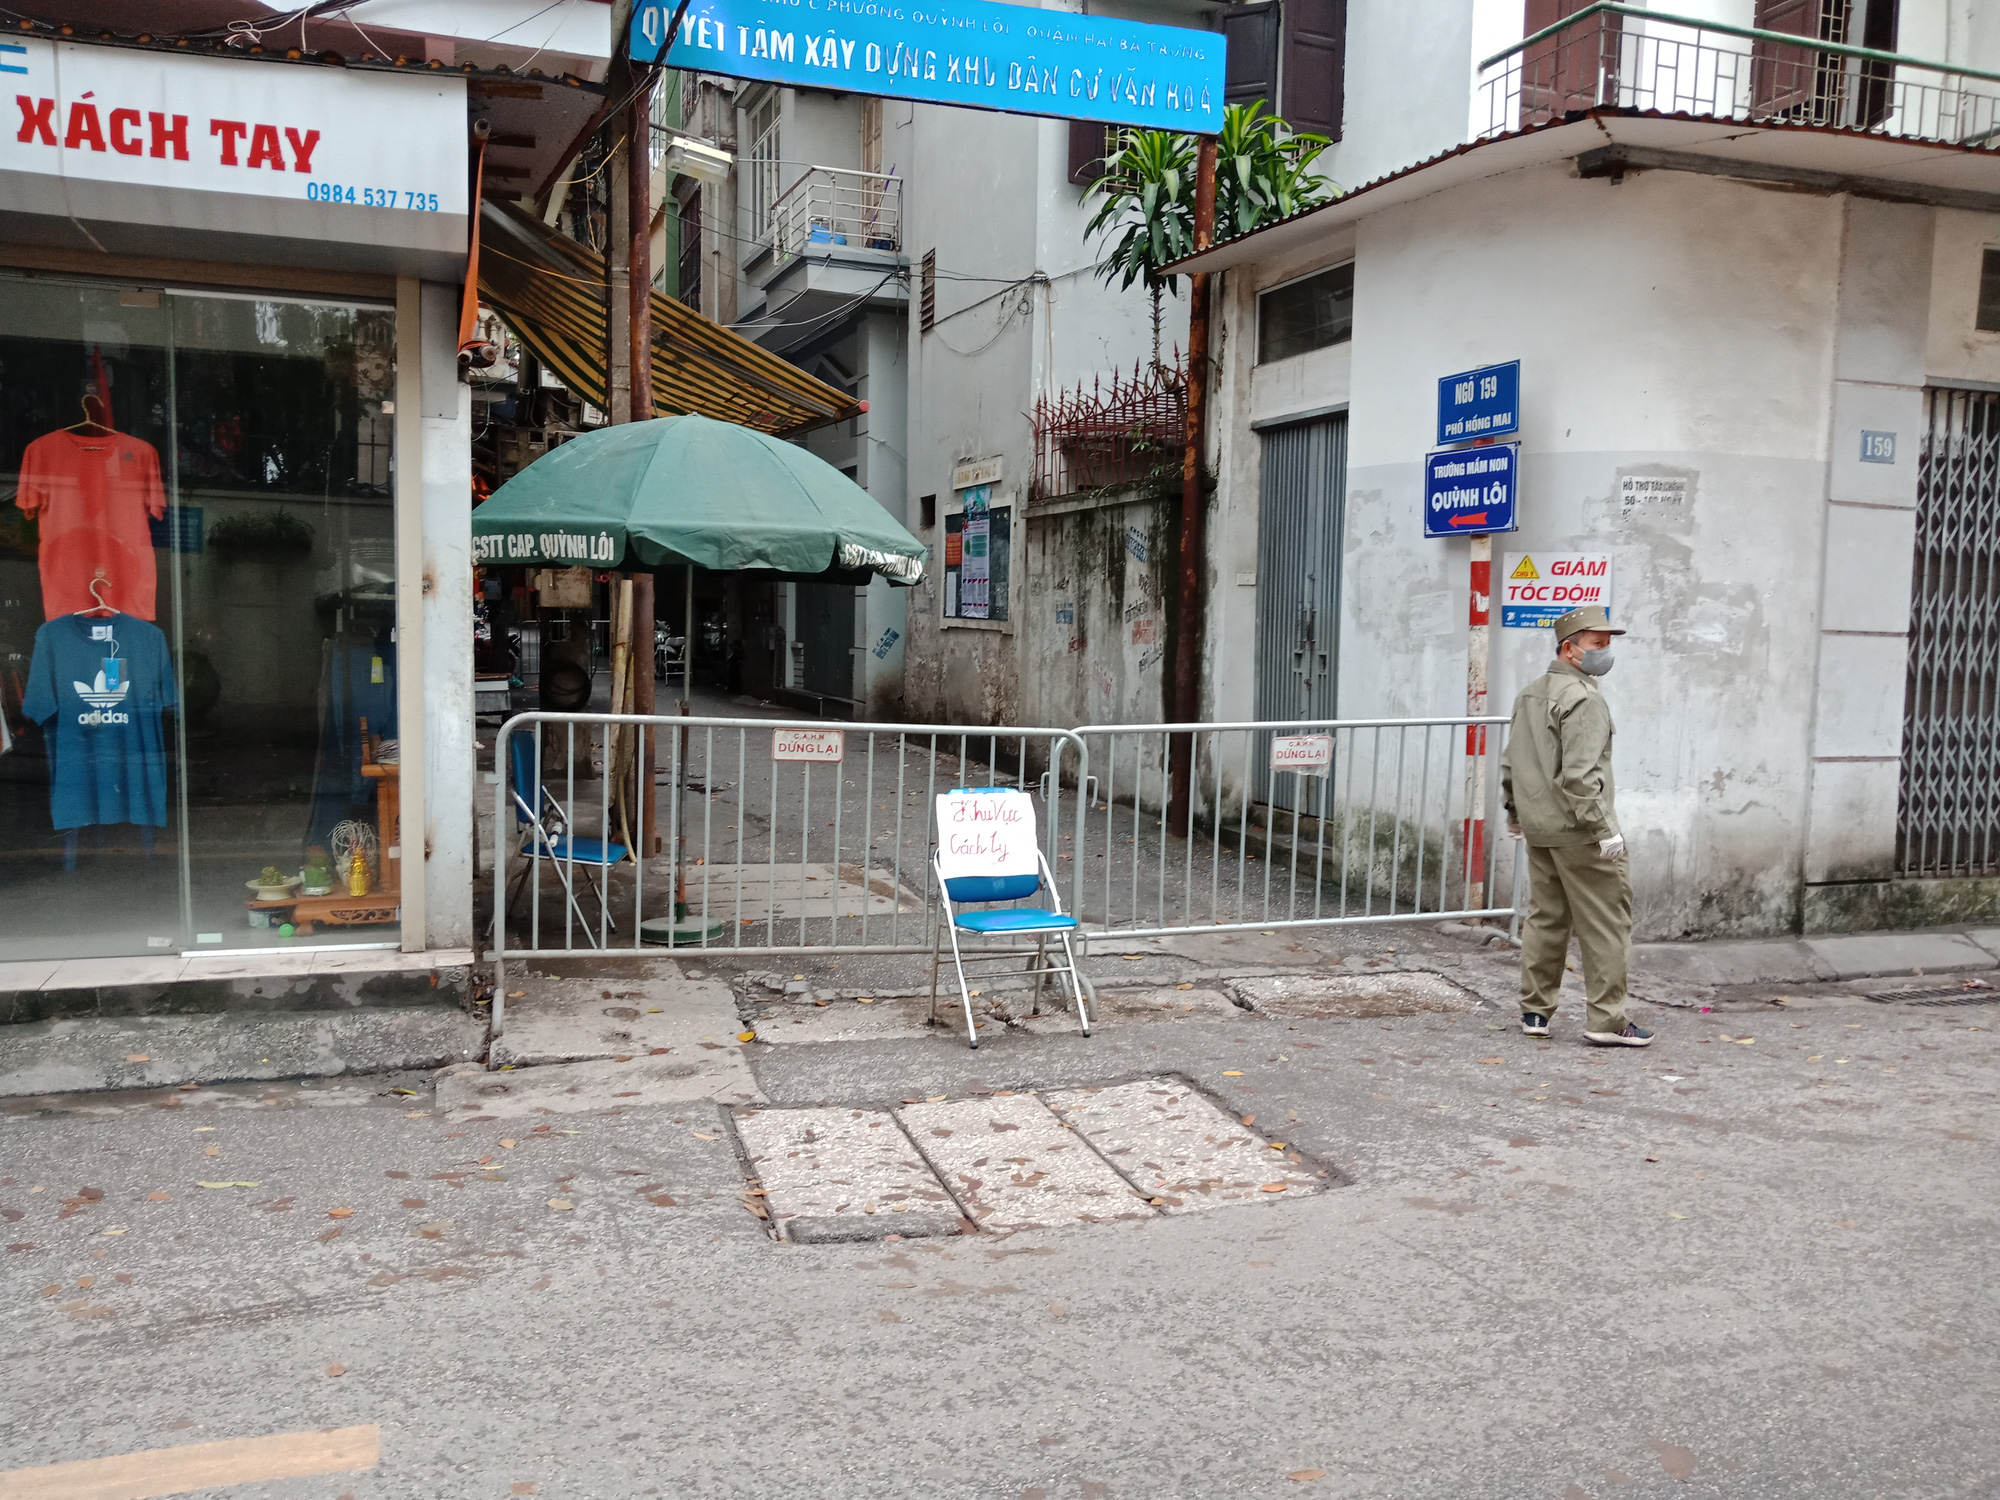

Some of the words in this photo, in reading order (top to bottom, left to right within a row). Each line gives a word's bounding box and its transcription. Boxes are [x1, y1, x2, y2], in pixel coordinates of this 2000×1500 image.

[1120, 34, 1141, 52] BÀ
[642, 5, 725, 52] QUYẾT
[737, 19, 795, 63] TÂM
[804, 29, 856, 70] XÂY
[865, 41, 937, 85] DỰNG
[946, 53, 996, 87] KHU
[1008, 54, 1060, 95] DÂN
[1070, 67, 1103, 100] CƯ
[1110, 67, 1156, 106] VĂN
[1166, 77, 1211, 115] HOÁ
[15, 90, 190, 162] XÁCH
[210, 118, 321, 174] TAY
[307, 182, 357, 205] 0984
[363, 187, 398, 209] 537
[405, 191, 440, 212] 735
[1454, 375, 1475, 405] NGÕ
[1479, 374, 1498, 400] 159
[1444, 416, 1465, 437] PHỐ
[1492, 411, 1512, 428] MAI
[1865, 435, 1893, 458] 159
[1489, 456, 1509, 472] NON
[1431, 485, 1480, 512] QUỲNH
[1482, 480, 1508, 506] LÔI
[472, 533, 505, 559] CSTT
[507, 533, 539, 558] CAP.
[539, 529, 587, 560] QUỲNH
[590, 531, 614, 561] LÔI
[1550, 556, 1608, 577] GIẢM
[1507, 580, 1551, 601] TỐC
[1551, 583, 1601, 604] ĐỘ!!!
[77, 709, 130, 725] adidas
[778, 740, 815, 753] DỪNG
[816, 744, 839, 756] LẠI
[1275, 747, 1306, 760] DỪNG
[1307, 749, 1326, 761] LẠI
[950, 833, 988, 855] Cách
